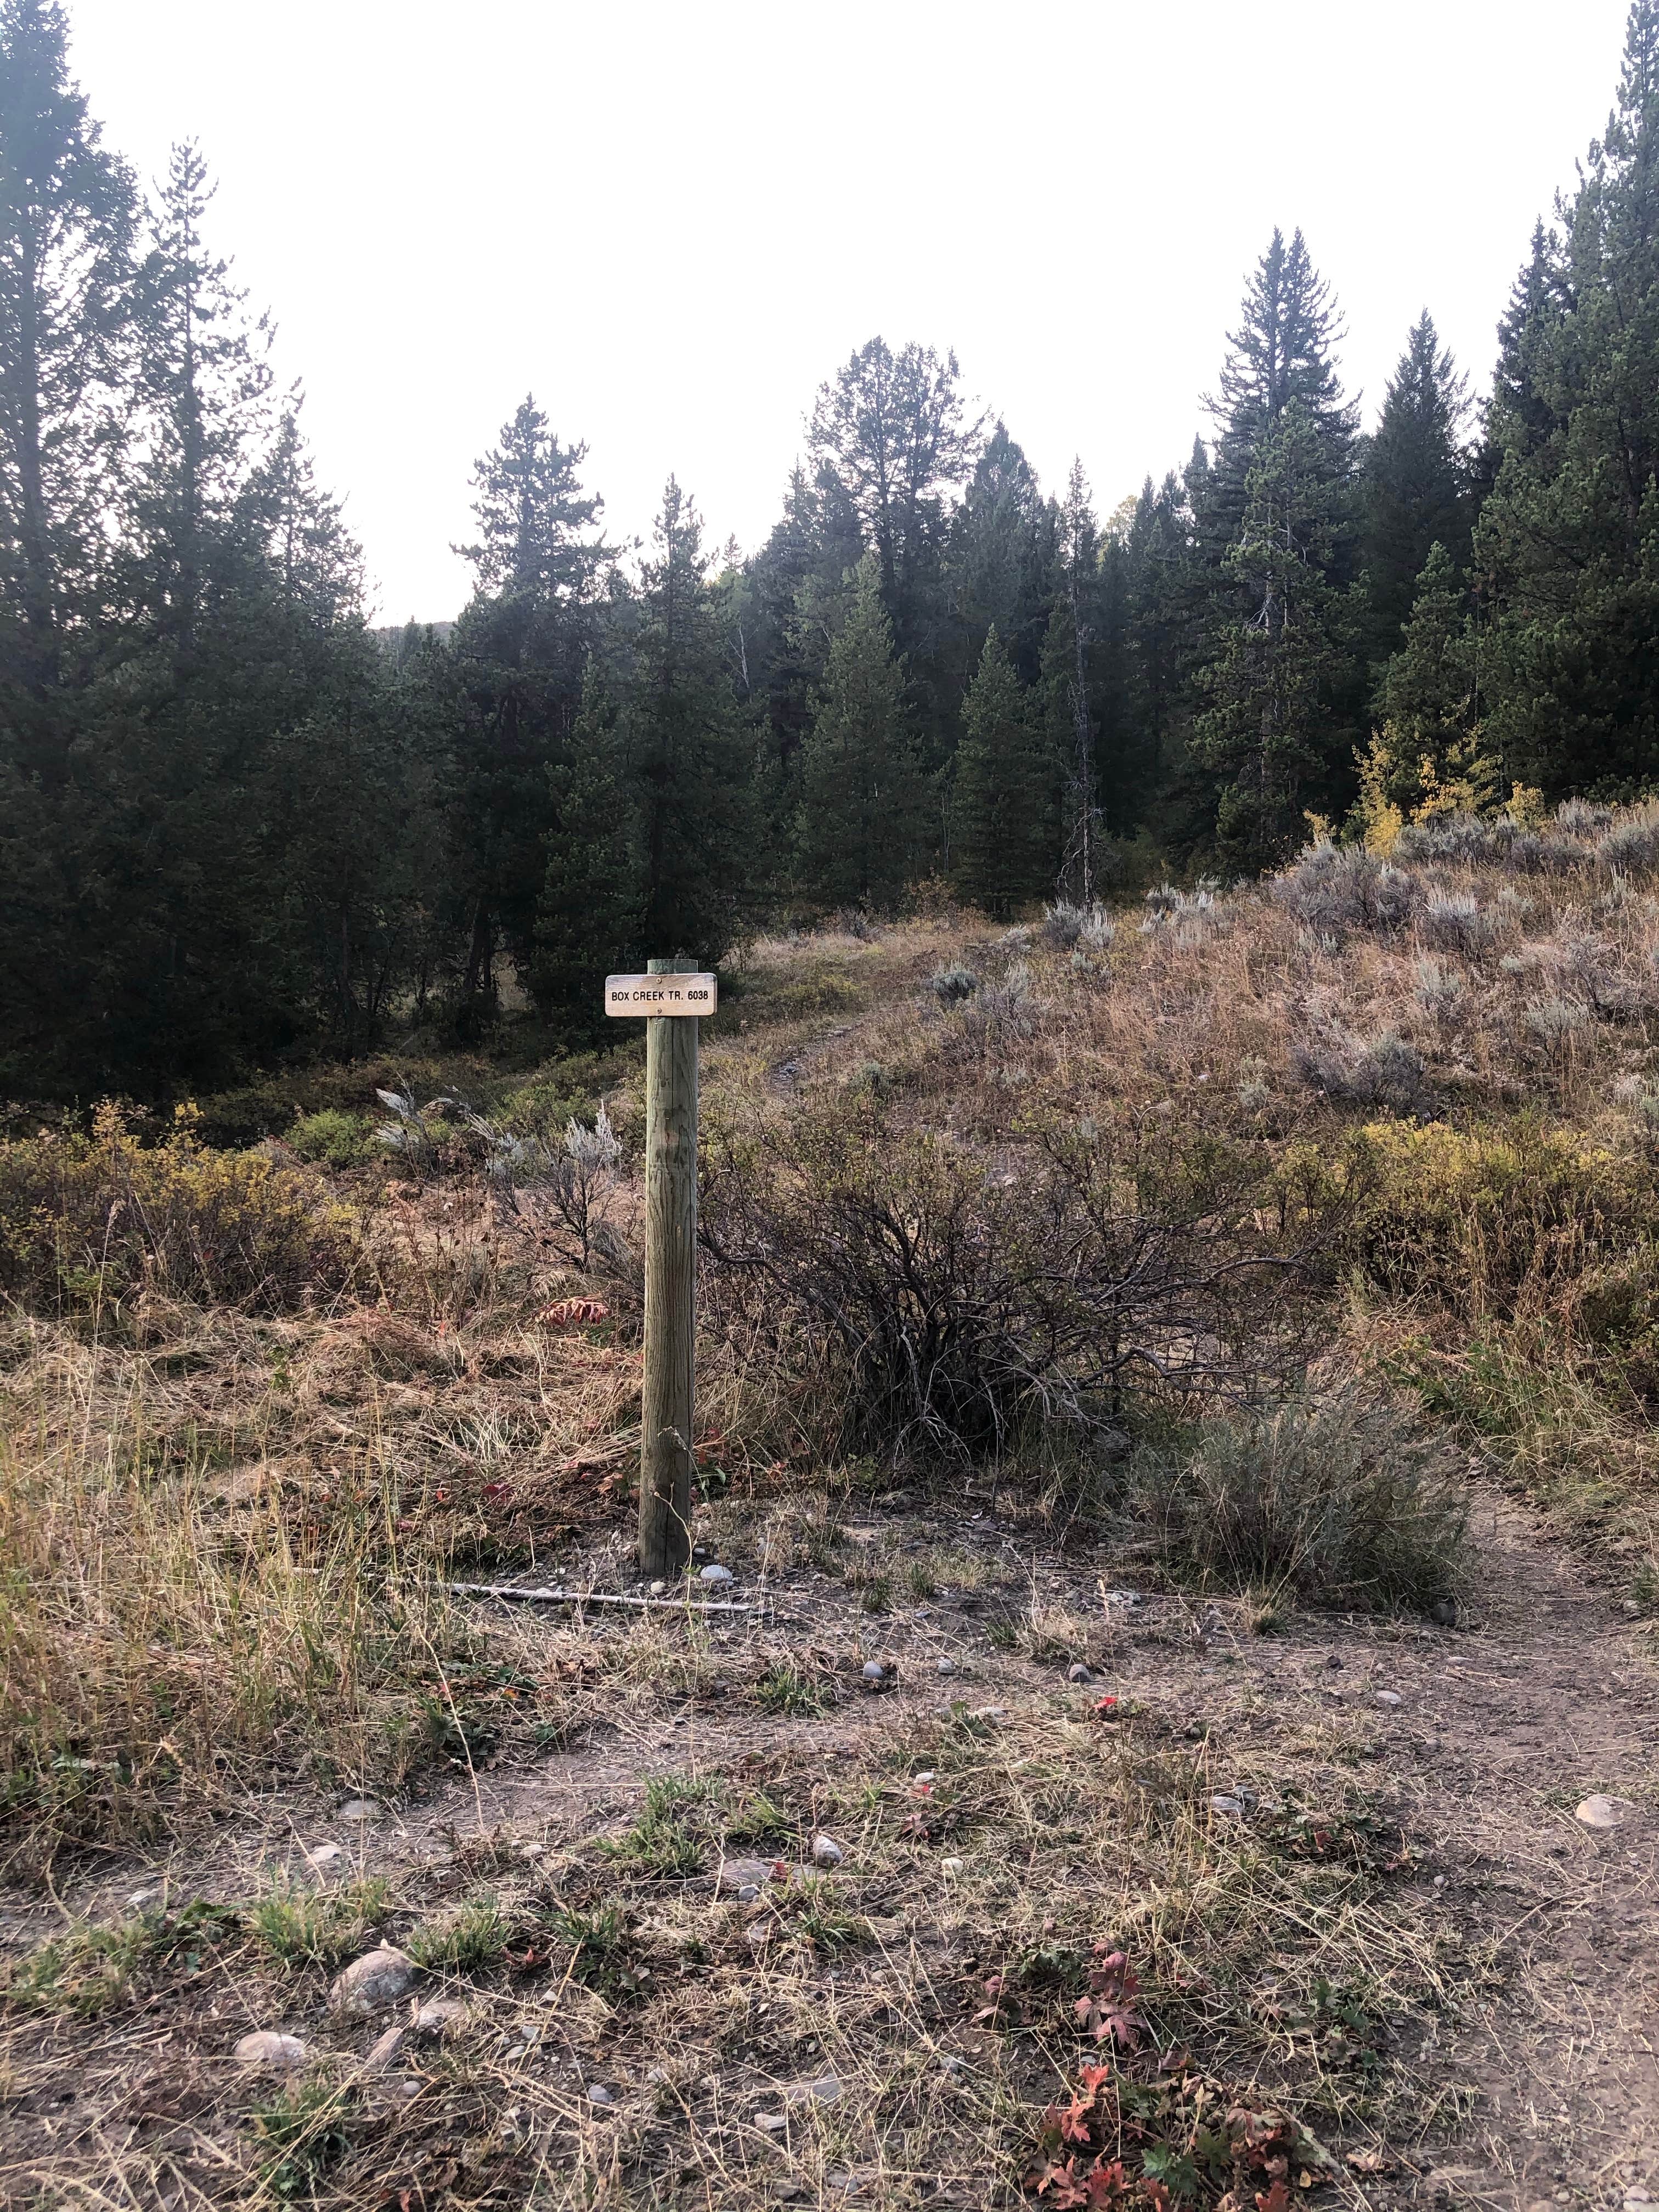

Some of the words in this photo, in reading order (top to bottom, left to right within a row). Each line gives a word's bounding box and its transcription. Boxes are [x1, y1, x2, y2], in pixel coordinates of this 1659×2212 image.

[612, 991, 629, 1001] BOX
[633, 991, 664, 1001] CREEK
[668, 991, 683, 1000] TR.
[688, 990, 708, 1000] 6038
